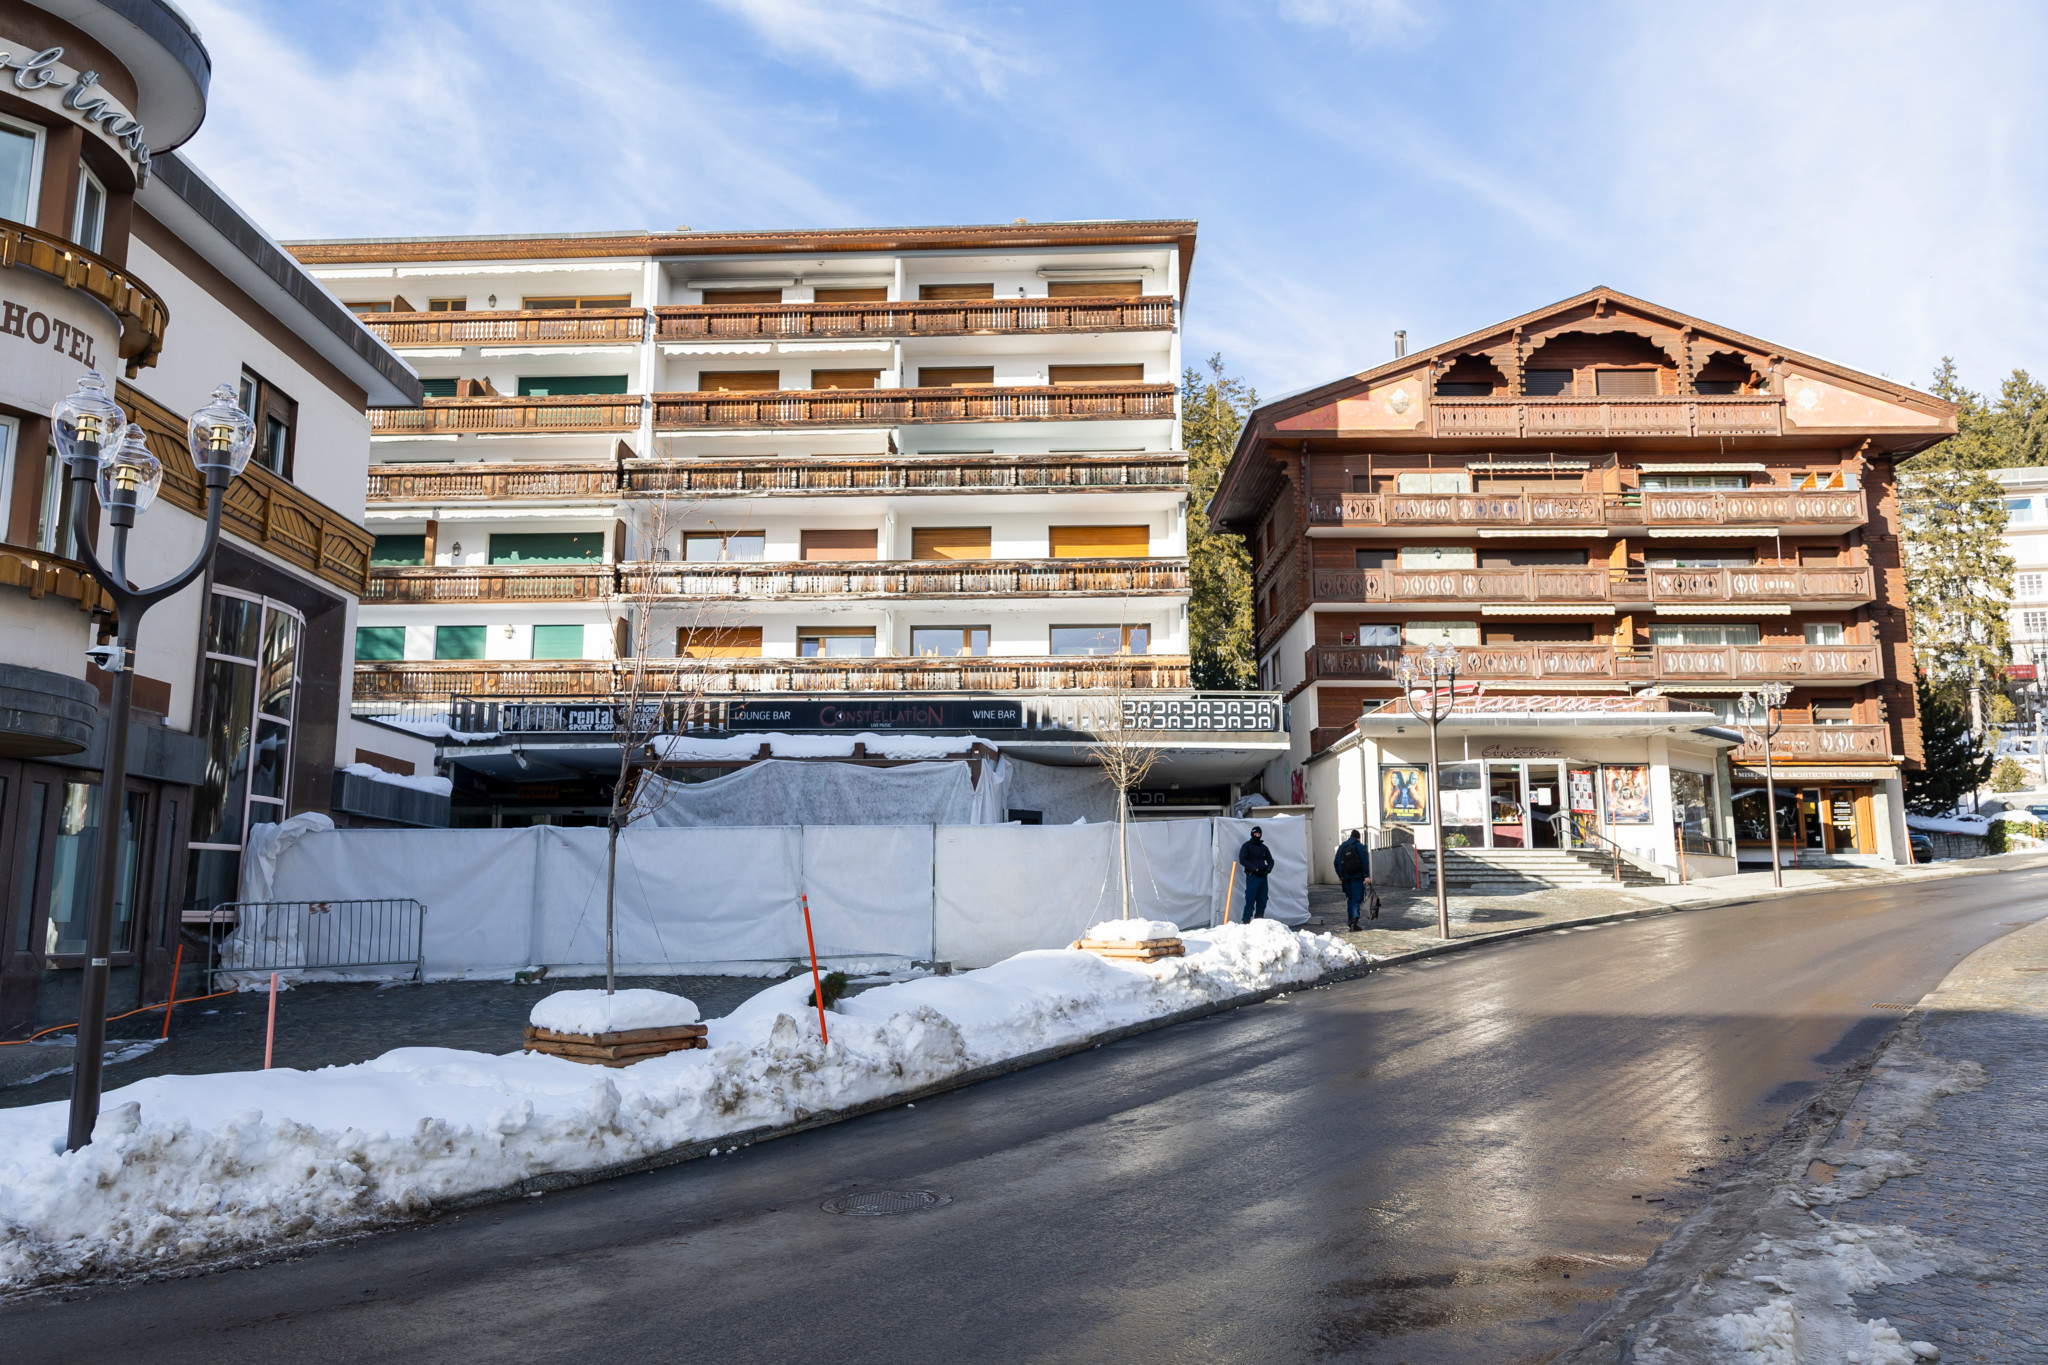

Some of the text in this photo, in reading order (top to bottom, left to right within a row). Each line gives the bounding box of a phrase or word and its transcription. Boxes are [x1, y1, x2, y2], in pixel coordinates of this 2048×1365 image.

[0, 299, 96, 370] HOTEL
[568, 707, 614, 725] rental
[734, 711, 791, 720] LOUNGE BAR
[972, 710, 1016, 719] WINE BAR
[594, 723, 615, 731] SHOP
